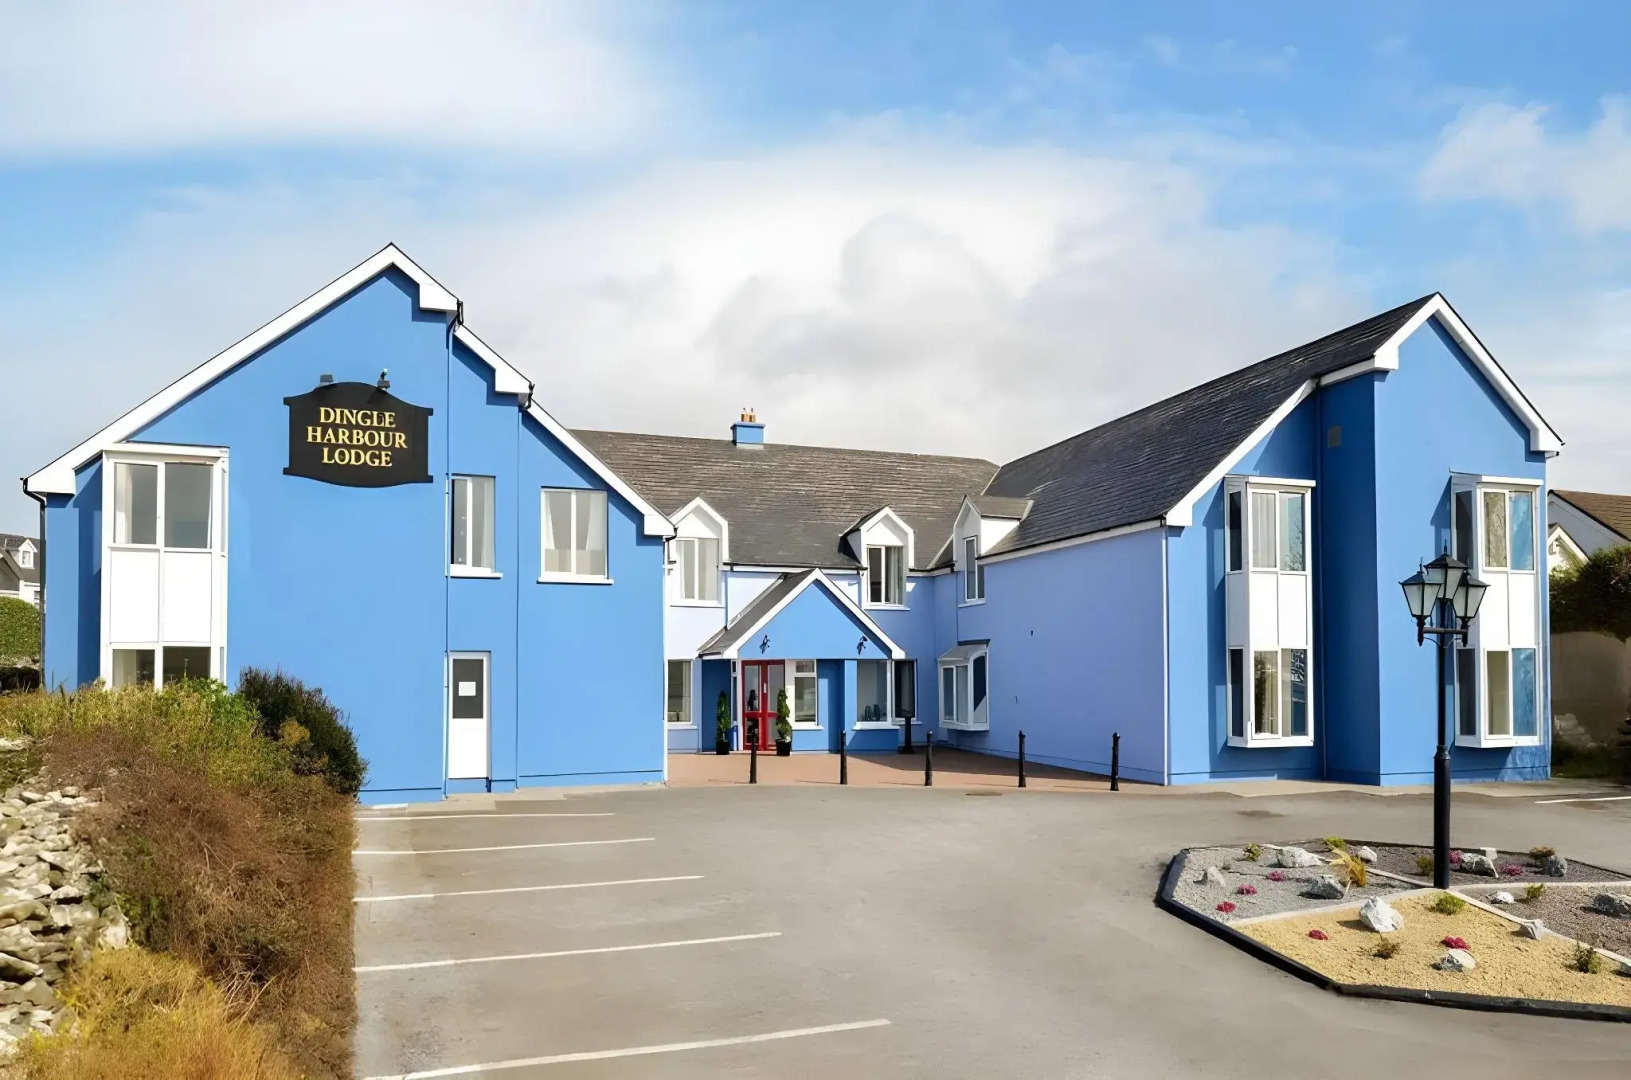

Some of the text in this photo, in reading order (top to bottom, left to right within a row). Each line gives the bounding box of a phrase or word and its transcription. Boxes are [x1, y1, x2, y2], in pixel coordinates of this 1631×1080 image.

[319, 407, 396, 428] DINGLE
[306, 426, 408, 449] HARBOUR
[321, 447, 393, 467] LODGE
